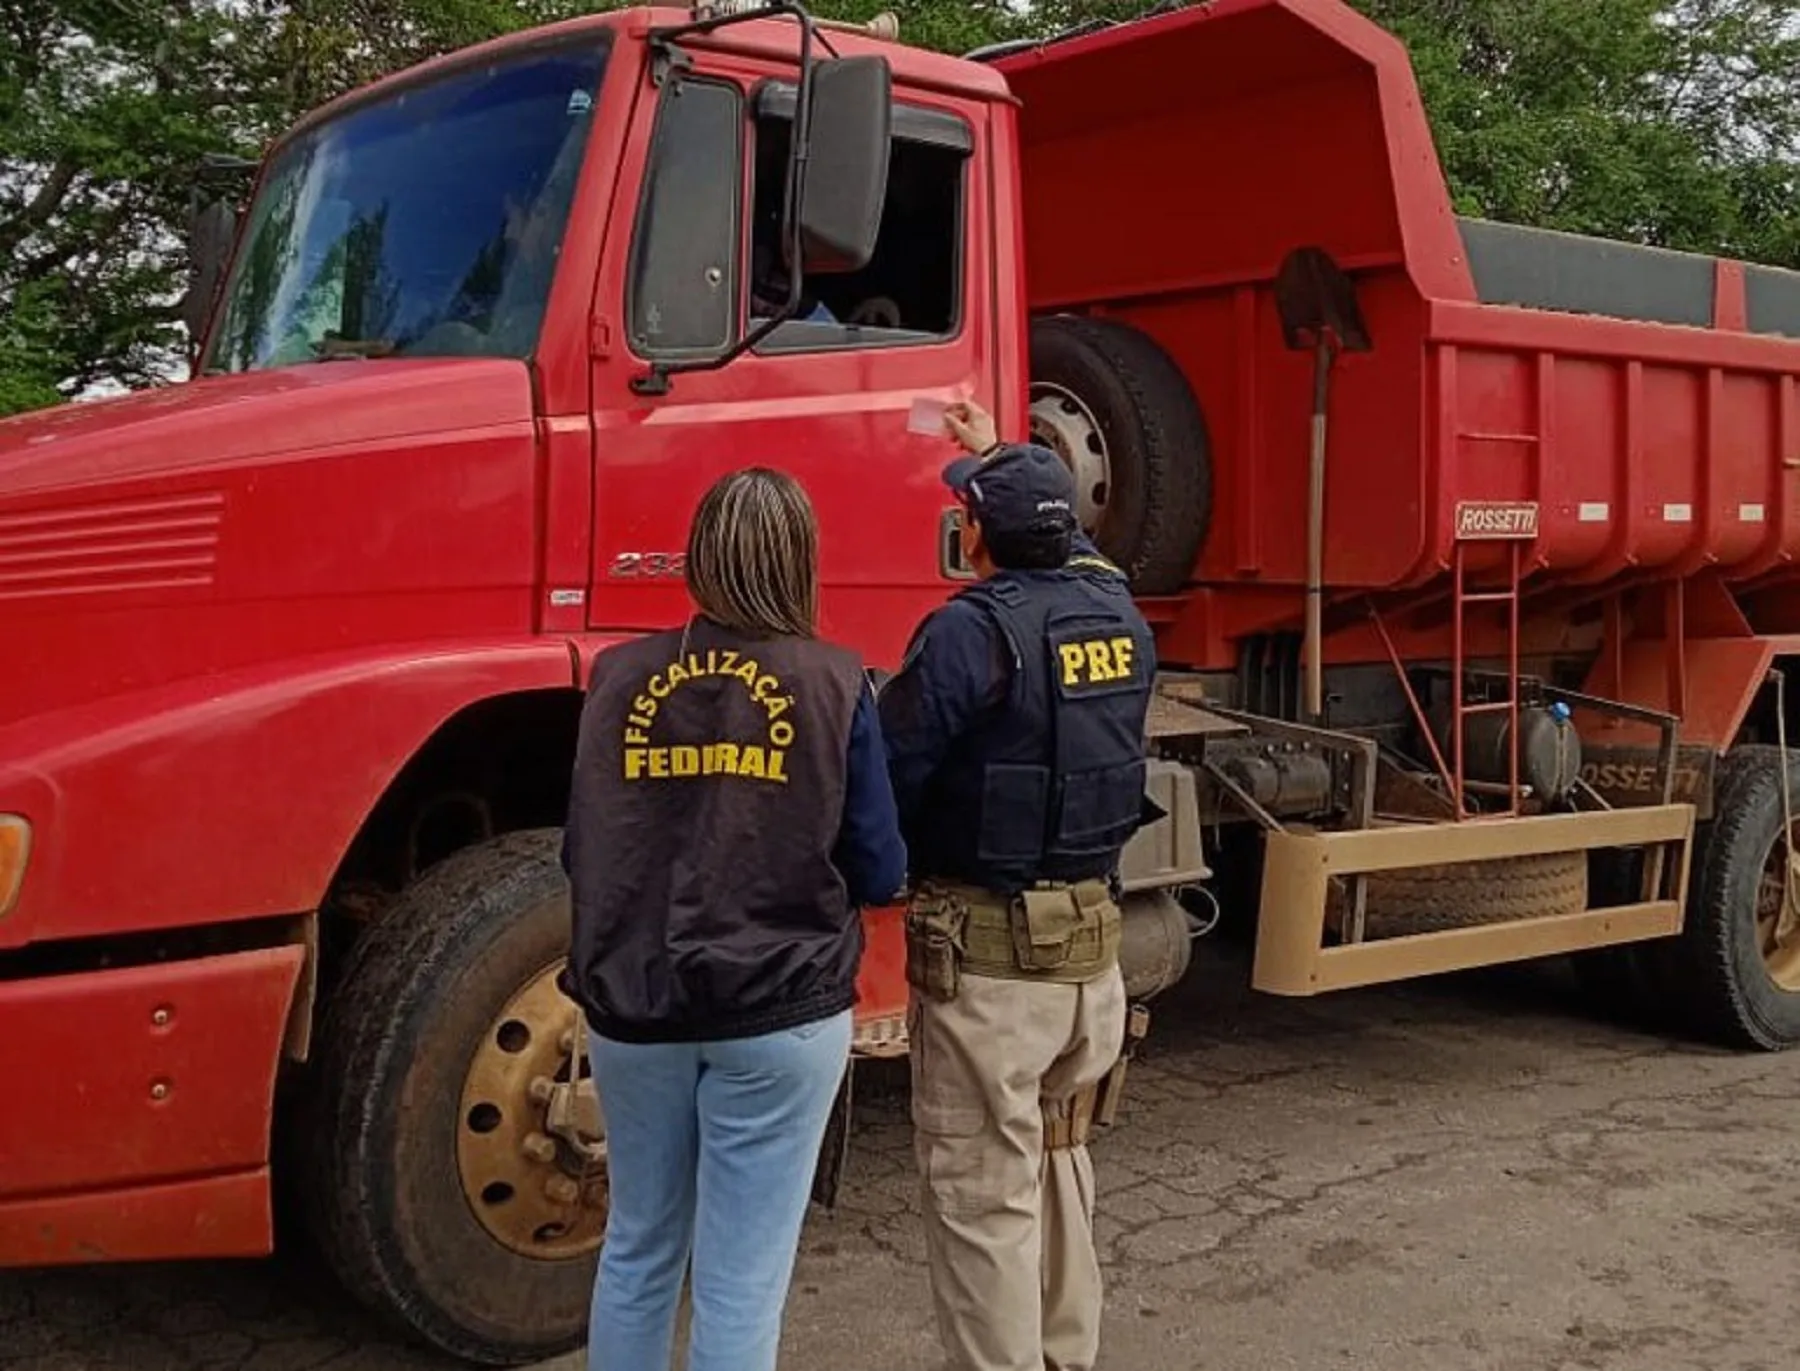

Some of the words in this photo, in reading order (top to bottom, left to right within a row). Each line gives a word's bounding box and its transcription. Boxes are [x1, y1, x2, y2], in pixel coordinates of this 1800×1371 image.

[1461, 508, 1535, 531] ROSSETTI
[1059, 636, 1133, 685] PRF
[625, 650, 795, 746] FISCALIZAÇÃO
